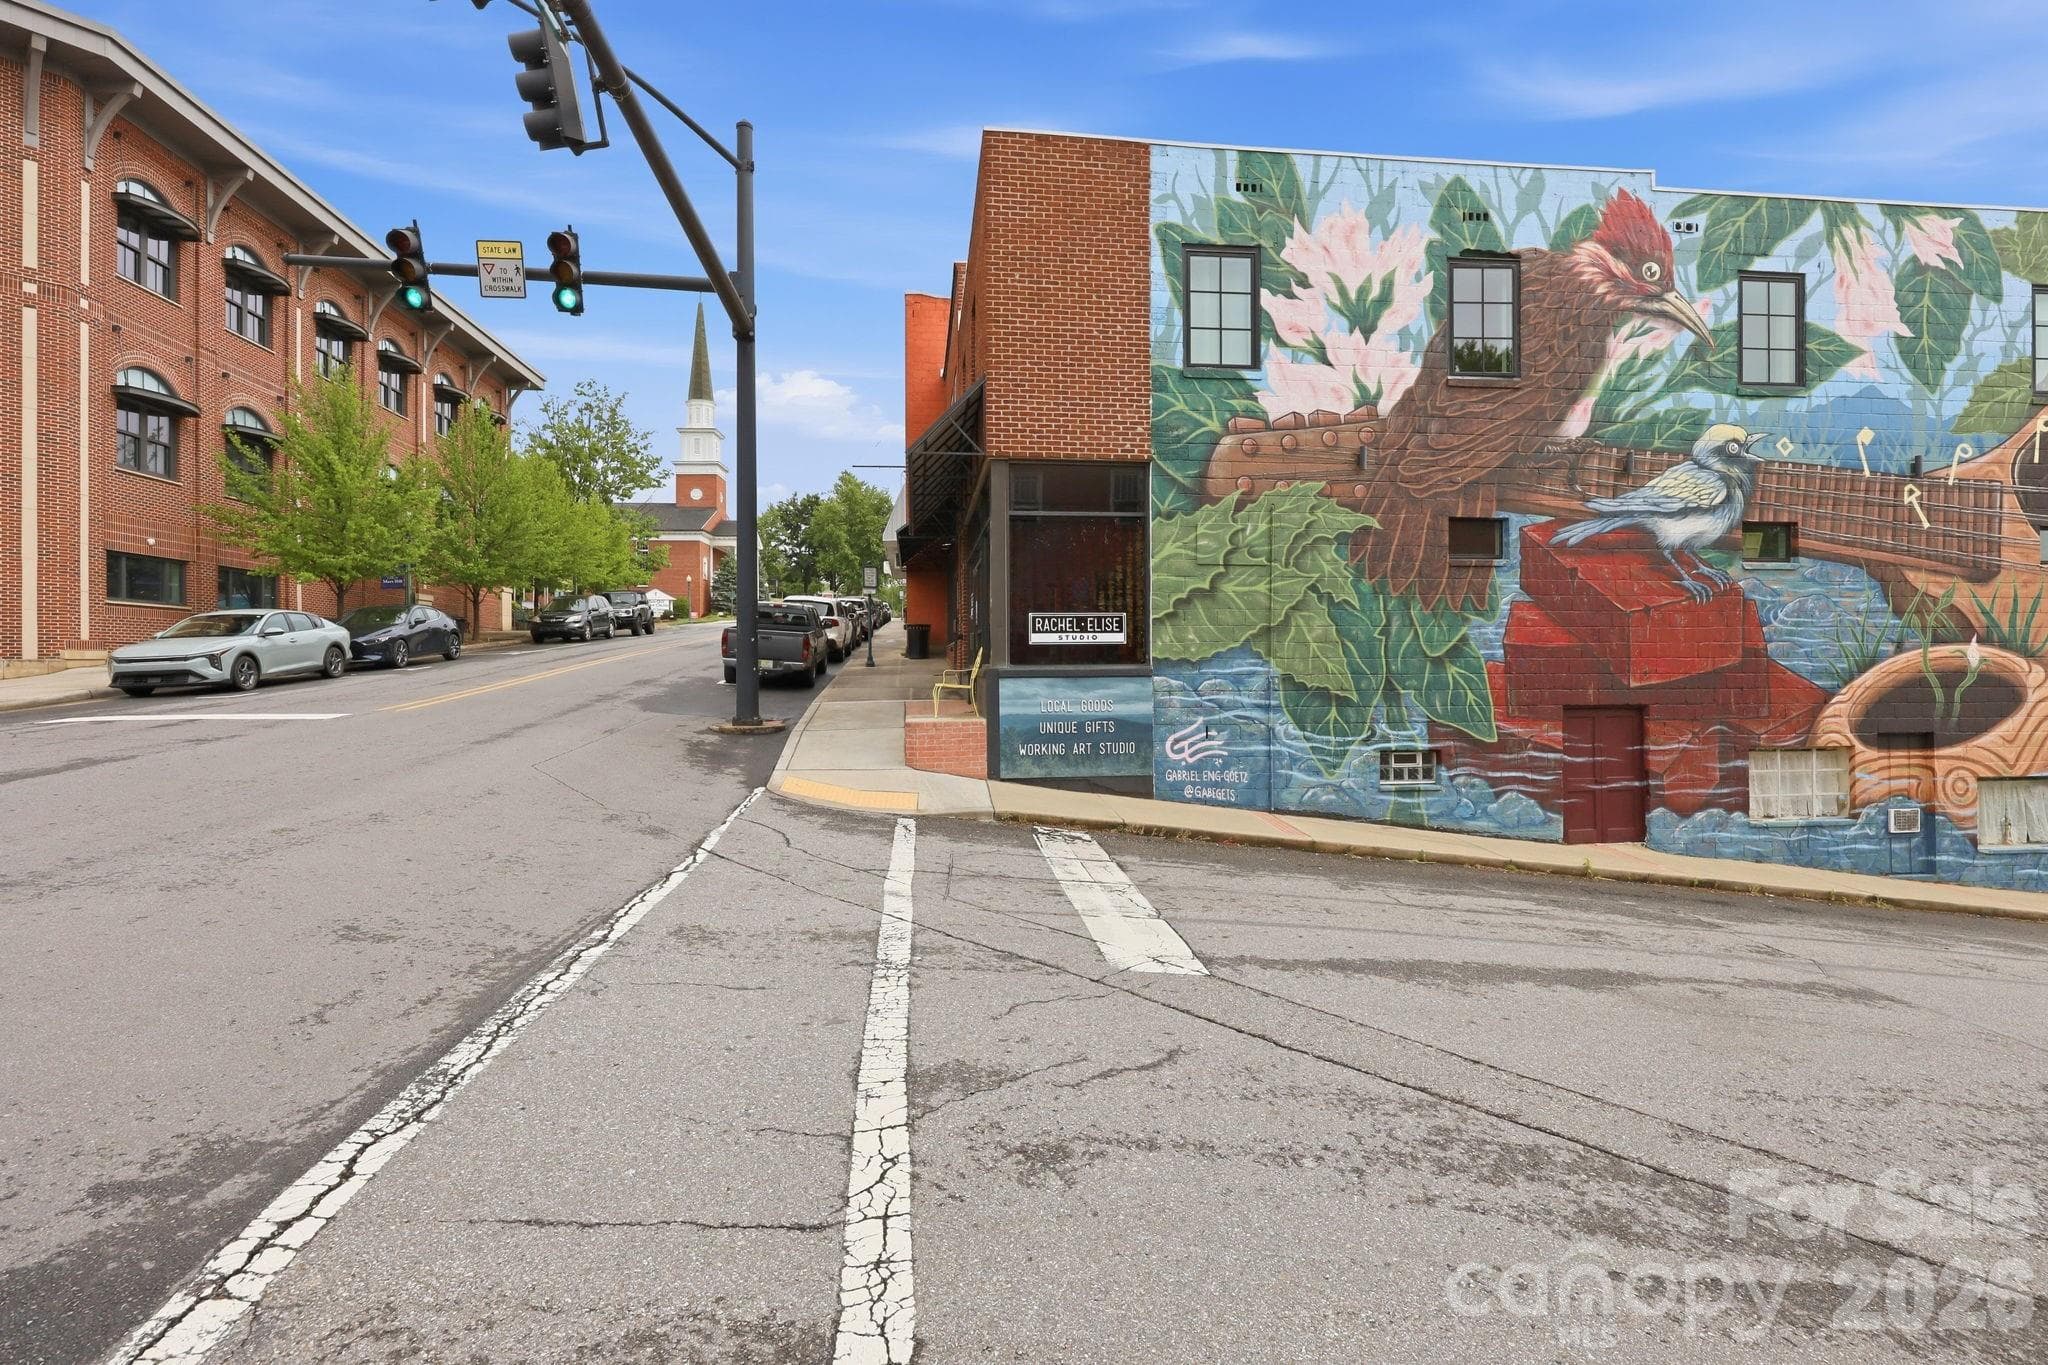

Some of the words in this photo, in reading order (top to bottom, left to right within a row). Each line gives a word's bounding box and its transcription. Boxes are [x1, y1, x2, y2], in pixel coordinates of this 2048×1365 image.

[482, 246, 502, 254] STATE
[499, 267, 508, 275] TO
[484, 285, 522, 293] CROSSWALK
[1035, 617, 1080, 632] RACHEL
[1087, 617, 1120, 632] ELISE
[1041, 699, 1073, 713] LOCAL
[1081, 699, 1114, 712] GOODS
[1040, 721, 1078, 734] UNIQUE
[1085, 720, 1115, 733] GIFTS
[1019, 742, 1066, 756] WORKING
[1072, 742, 1092, 755] ART
[1099, 741, 1136, 755] STUDIO
[1165, 769, 1201, 782] GABRIEL
[1202, 770, 1249, 783] ENG-GOETZ
